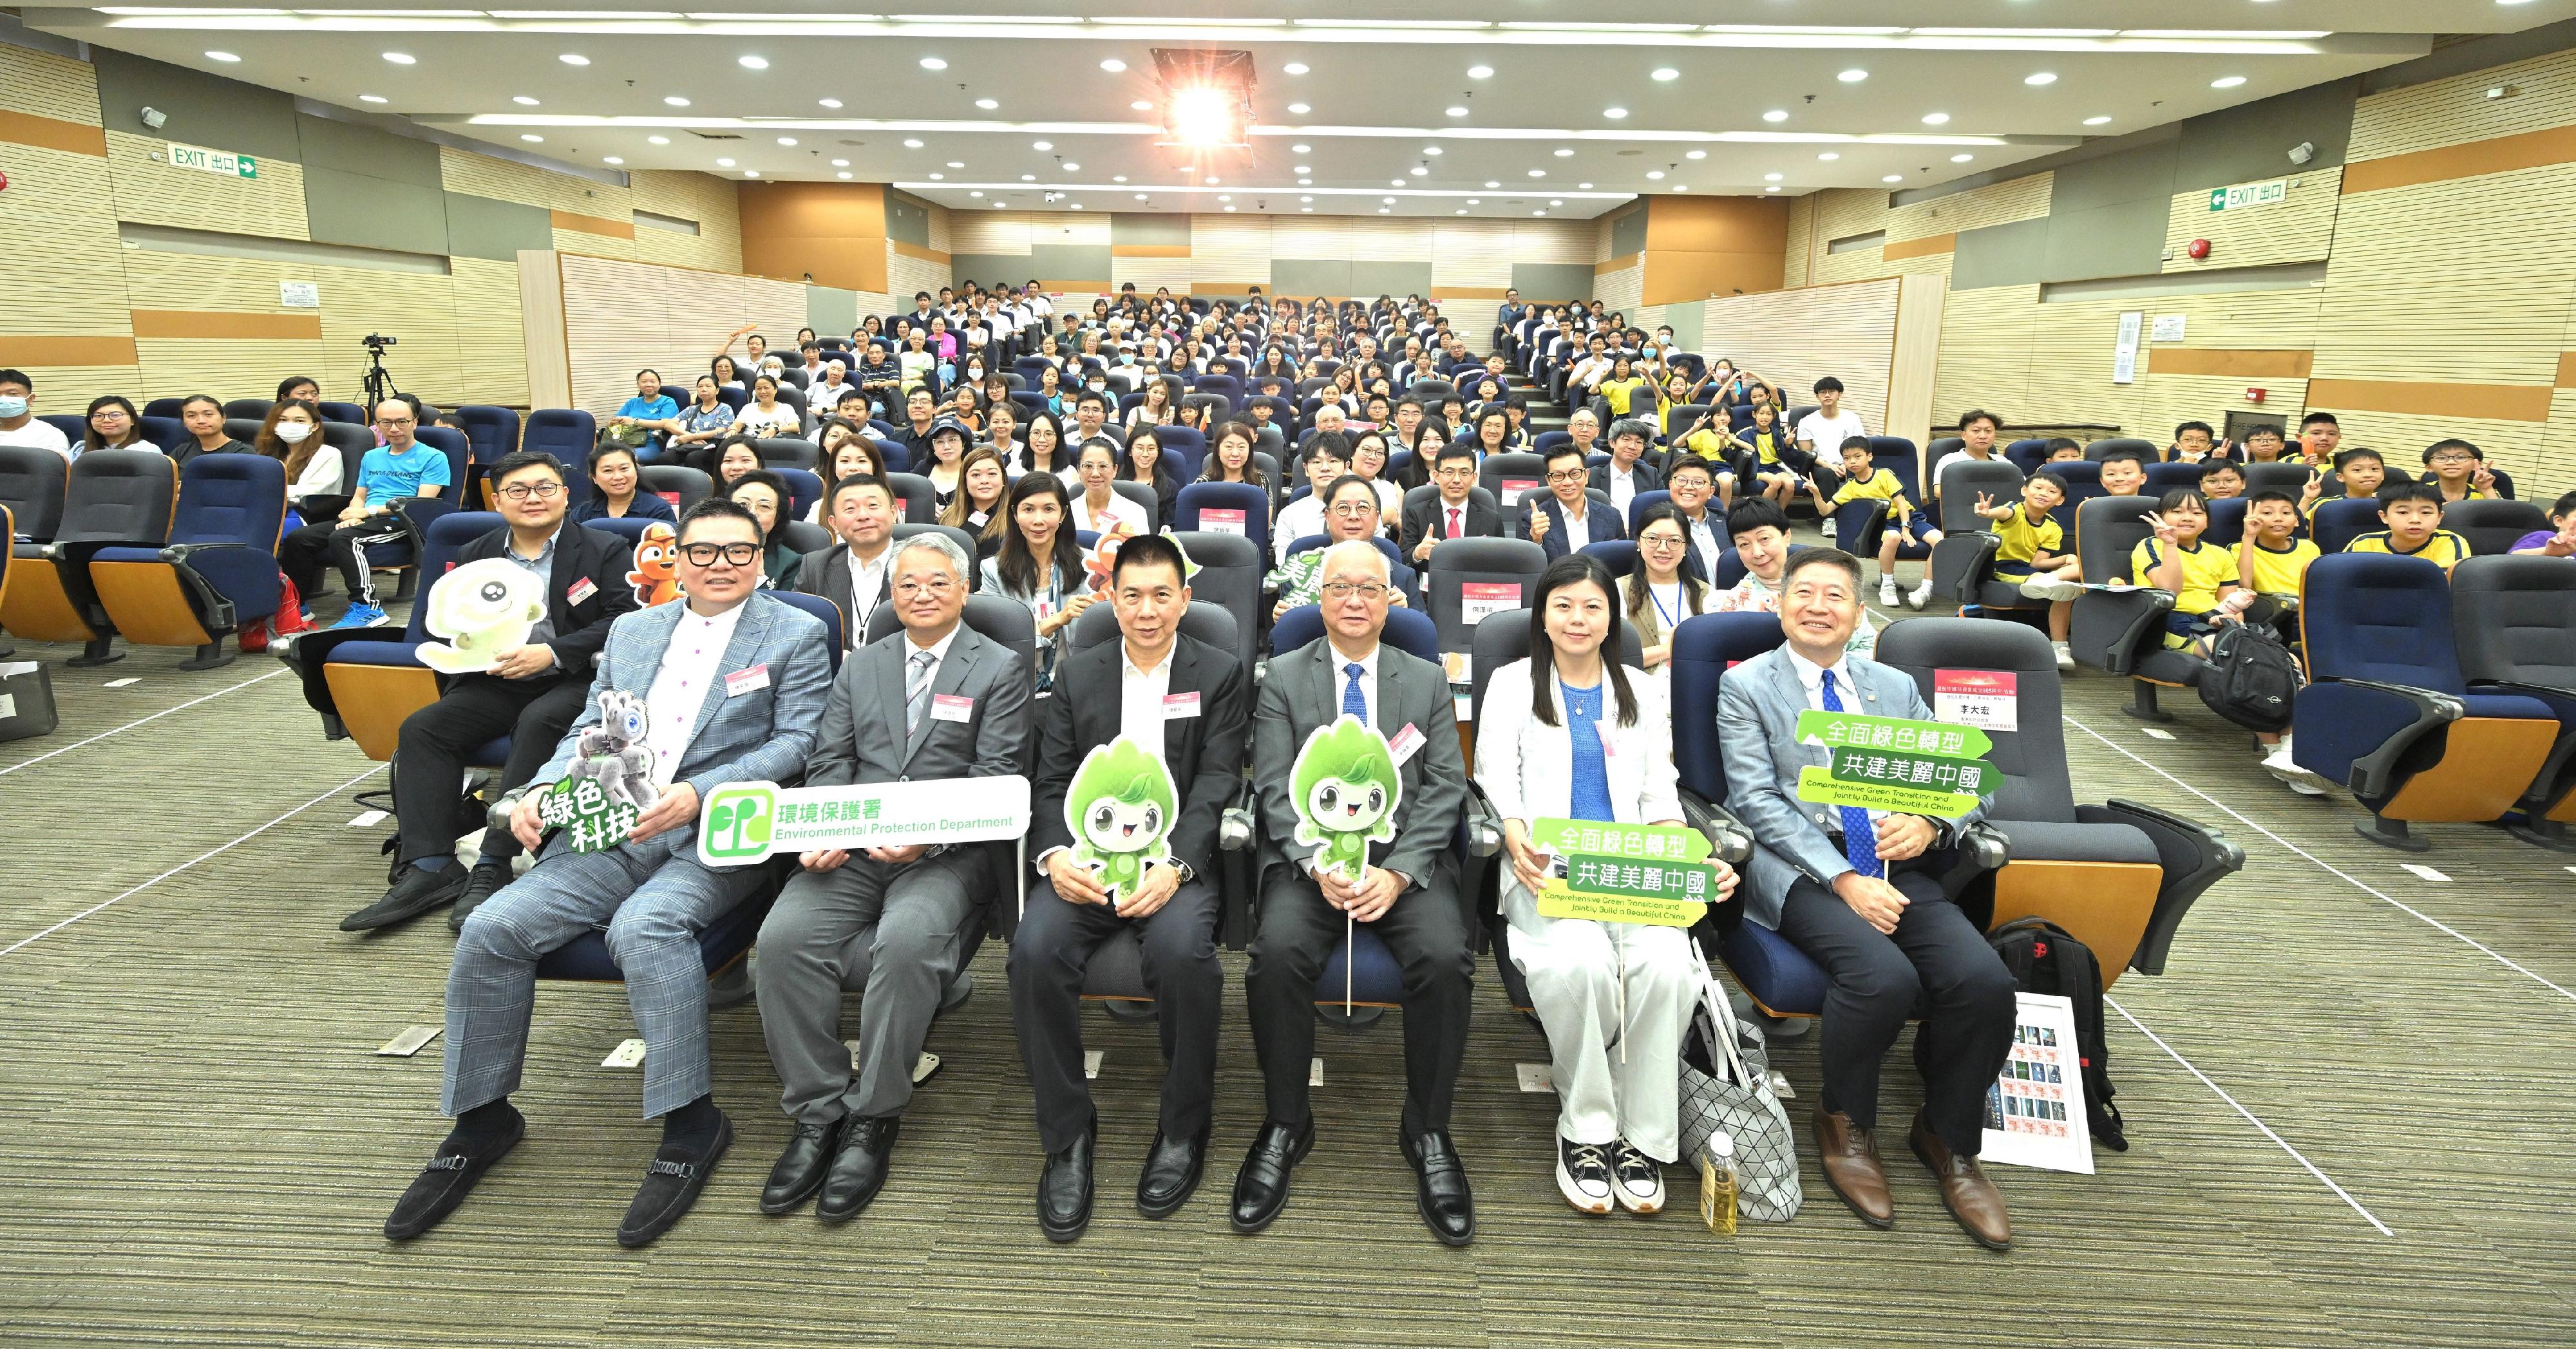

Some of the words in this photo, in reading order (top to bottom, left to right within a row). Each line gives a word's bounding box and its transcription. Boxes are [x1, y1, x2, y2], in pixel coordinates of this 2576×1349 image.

[175, 148, 205, 167] EXIT
[211, 155, 234, 171] 出口
[2230, 187, 2257, 205] EXIT
[2260, 184, 2281, 200] 出口
[1960, 704, 1990, 715] 李大宏
[1826, 721, 1963, 754] 全面綠色轉型
[1841, 753, 1981, 789] 共建美麗中國
[540, 780, 607, 825] 綠色
[1806, 780, 1865, 793] Comprehensive
[1867, 786, 1890, 795] Green
[1893, 789, 1931, 800] Transition
[1933, 794, 1949, 802] and
[1833, 791, 1860, 802] Jointly
[1862, 794, 1882, 803] Build
[1891, 797, 1929, 809] Beautiful
[1931, 802, 1954, 811] China
[777, 799, 882, 824] 環境保護署
[571, 805, 637, 853] 科技
[775, 824, 867, 840] Environmental
[871, 821, 936, 835] Protection
[939, 816, 1013, 831] Department
[1560, 827, 1686, 859] 全面綠色轉型
[1576, 860, 1706, 894] 共建美麗中國
[1544, 892, 1601, 904] Comprehensive
[1602, 896, 1625, 905] Green
[1627, 899, 1663, 909] Transition
[1665, 902, 1680, 910] and
[1571, 904, 1597, 914] Jointly
[1599, 906, 1618, 914] Build
[1626, 909, 1662, 919] Beautiful
[1664, 912, 1685, 920] China
